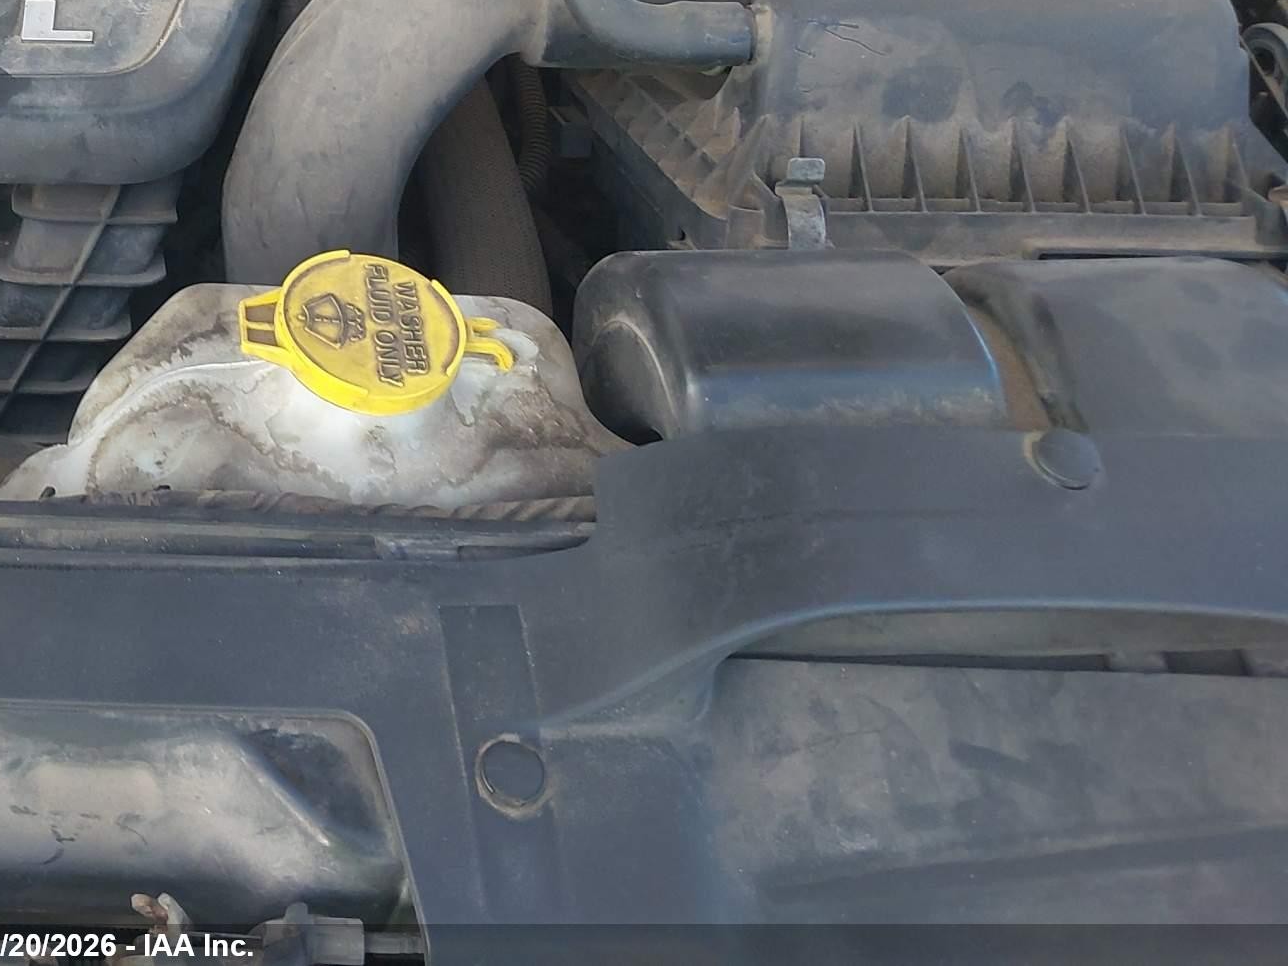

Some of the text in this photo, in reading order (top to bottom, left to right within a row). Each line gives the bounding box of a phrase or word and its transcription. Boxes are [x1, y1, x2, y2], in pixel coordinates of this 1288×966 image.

[363, 262, 405, 388] FLUID ONLY
[393, 281, 429, 375] WASHER
